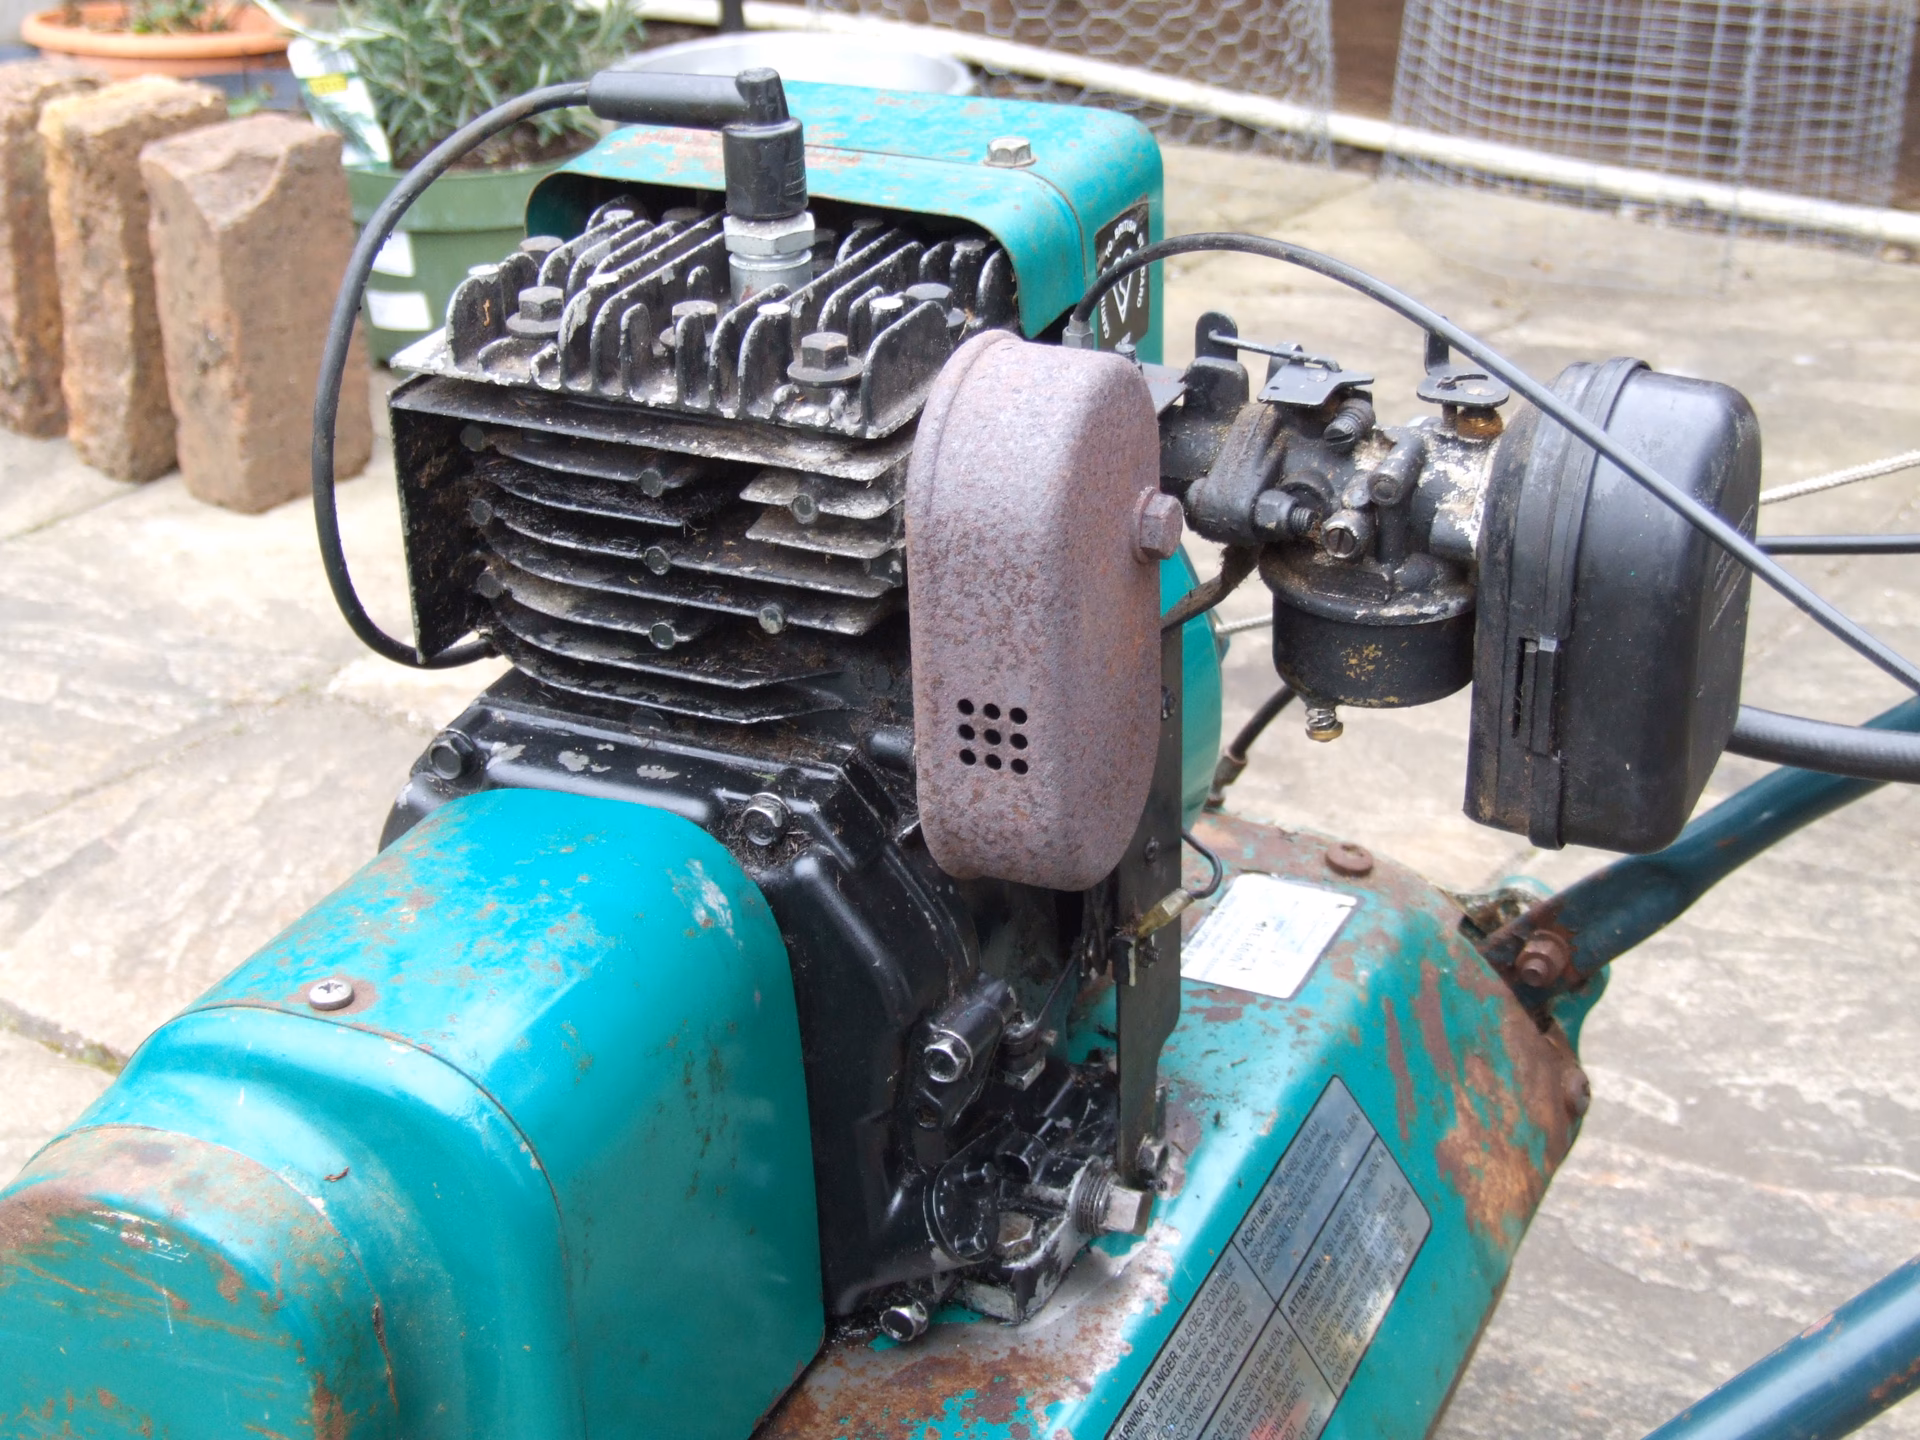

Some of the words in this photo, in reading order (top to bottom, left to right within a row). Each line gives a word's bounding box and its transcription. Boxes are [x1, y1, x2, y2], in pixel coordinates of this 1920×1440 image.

[1105, 240, 1113, 256] TO
[1114, 219, 1138, 240] BRITISH
[1137, 231, 1146, 308] STDARD
[1239, 1195, 1274, 1250] ACHTUNG!
[1258, 1209, 1299, 1277] ABSCHALTEN
[1294, 1189, 1312, 1218] UND
[1306, 1157, 1331, 1197] MOTOR
[1286, 1255, 1323, 1318] ATTENTION!
[1329, 1207, 1351, 1245] LAMES
[1295, 1277, 1327, 1332] TOURNER
[1322, 1250, 1343, 1285] MEME
[1337, 1220, 1360, 1259] APRES
[1354, 1201, 1371, 1229] QUE
[1348, 1245, 1362, 1268] AIT
[1151, 1381, 1178, 1423] AFTER
[1172, 1341, 1202, 1388] ENGINE
[1196, 1330, 1209, 1349] IS
[1203, 1278, 1240, 1338] SWITCHED
[1175, 1305, 1206, 1353] BLADES
[1200, 1255, 1236, 1313] CONTINUE
[1313, 1306, 1344, 1360] POSITION
[1356, 1243, 1379, 1282] AVANT
[1322, 1338, 1342, 1372] TOUT
[1337, 1300, 1363, 1345] TRAVAIL
[1358, 1279, 1374, 1307] SUR
[1369, 1260, 1384, 1287] LES
[1379, 1231, 1401, 1269] LAMES
[1395, 1218, 1408, 1239] DE
[1174, 1358, 1210, 1417] WORKING
[1204, 1341, 1220, 1366] ON
[1215, 1296, 1247, 1349] CUTTING
[1209, 1344, 1236, 1388] SPARK
[1219, 1411, 1233, 1434] DE
[1228, 1367, 1259, 1419] MESSEN
[1253, 1323, 1284, 1375] DRAAIEN
[1240, 1384, 1267, 1427] NADAT
[1261, 1368, 1275, 1392] DE
[1270, 1331, 1297, 1376] MOTOR
[1263, 1395, 1278, 1420] DE
